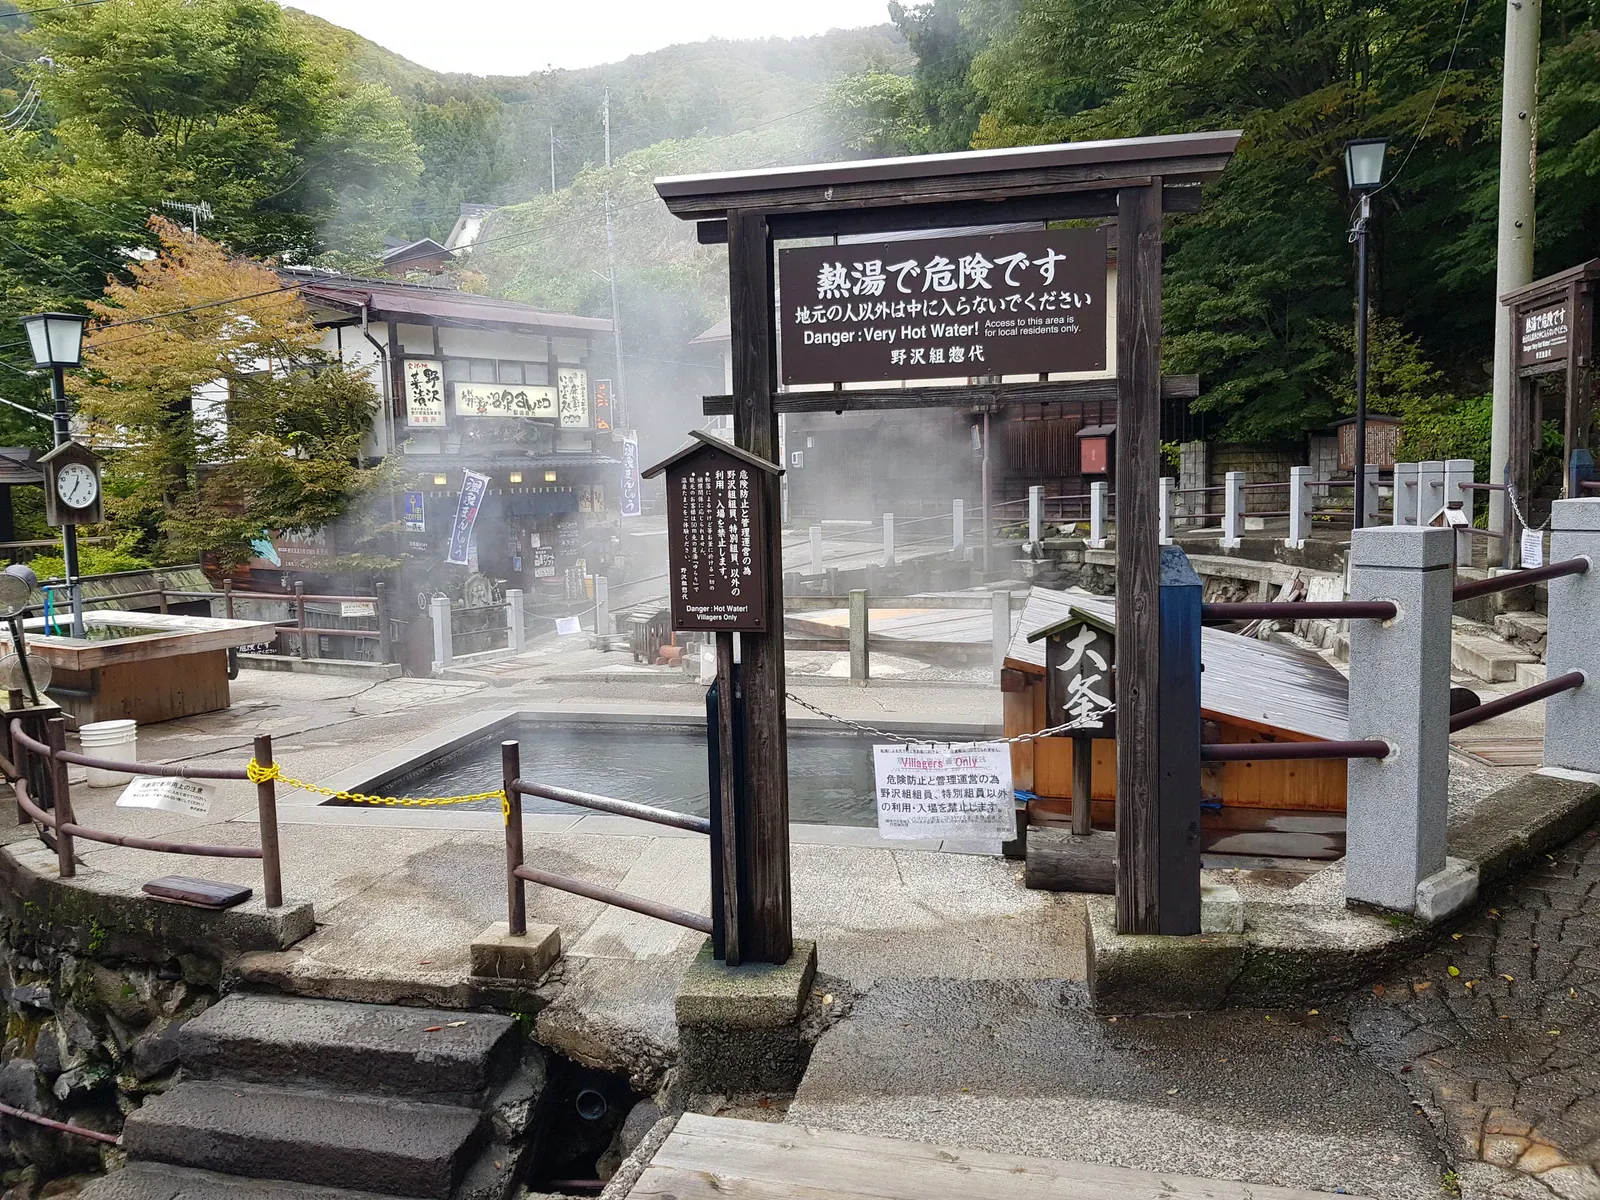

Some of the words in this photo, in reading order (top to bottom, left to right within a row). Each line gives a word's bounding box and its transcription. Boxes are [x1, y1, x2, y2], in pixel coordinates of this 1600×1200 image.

[816, 247, 1067, 300] 熱湯で危険です
[795, 290, 1092, 324] 地元の人以外は中に入らないでください
[864, 327, 896, 344] Very
[901, 324, 927, 340] Hot
[931, 321, 979, 338] Water!
[984, 329, 997, 337] for
[998, 327, 1018, 336] local
[1019, 325, 1059, 335] residents
[1061, 324, 1081, 334] only.
[985, 320, 1015, 329] Access
[1027, 317, 1043, 325] this
[1045, 317, 1064, 325] area
[1066, 315, 1074, 323] is
[890, 345, 985, 366] 野沢組惣代
[423, 368, 442, 402] 野沢
[454, 477, 483, 557] 温泉まんじゅう
[715, 470, 728, 580] 利用・入場を禁止します。
[739, 470, 752, 576] 危険防止と管理運営の為
[727, 470, 741, 597] 野沢組組員、特別組員、以外の
[696, 614, 722, 622] Villagers
[723, 614, 738, 622] Only
[1056, 623, 1112, 728] 大釜
[902, 757, 944, 770] Villagers
[955, 757, 979, 769] Only
[886, 774, 1000, 786] 危険防止と管理運営の為
[880, 787, 1008, 800] 野沢組組員、特別組員以外
[881, 801, 1003, 813] の利用・入場を禁止します。
